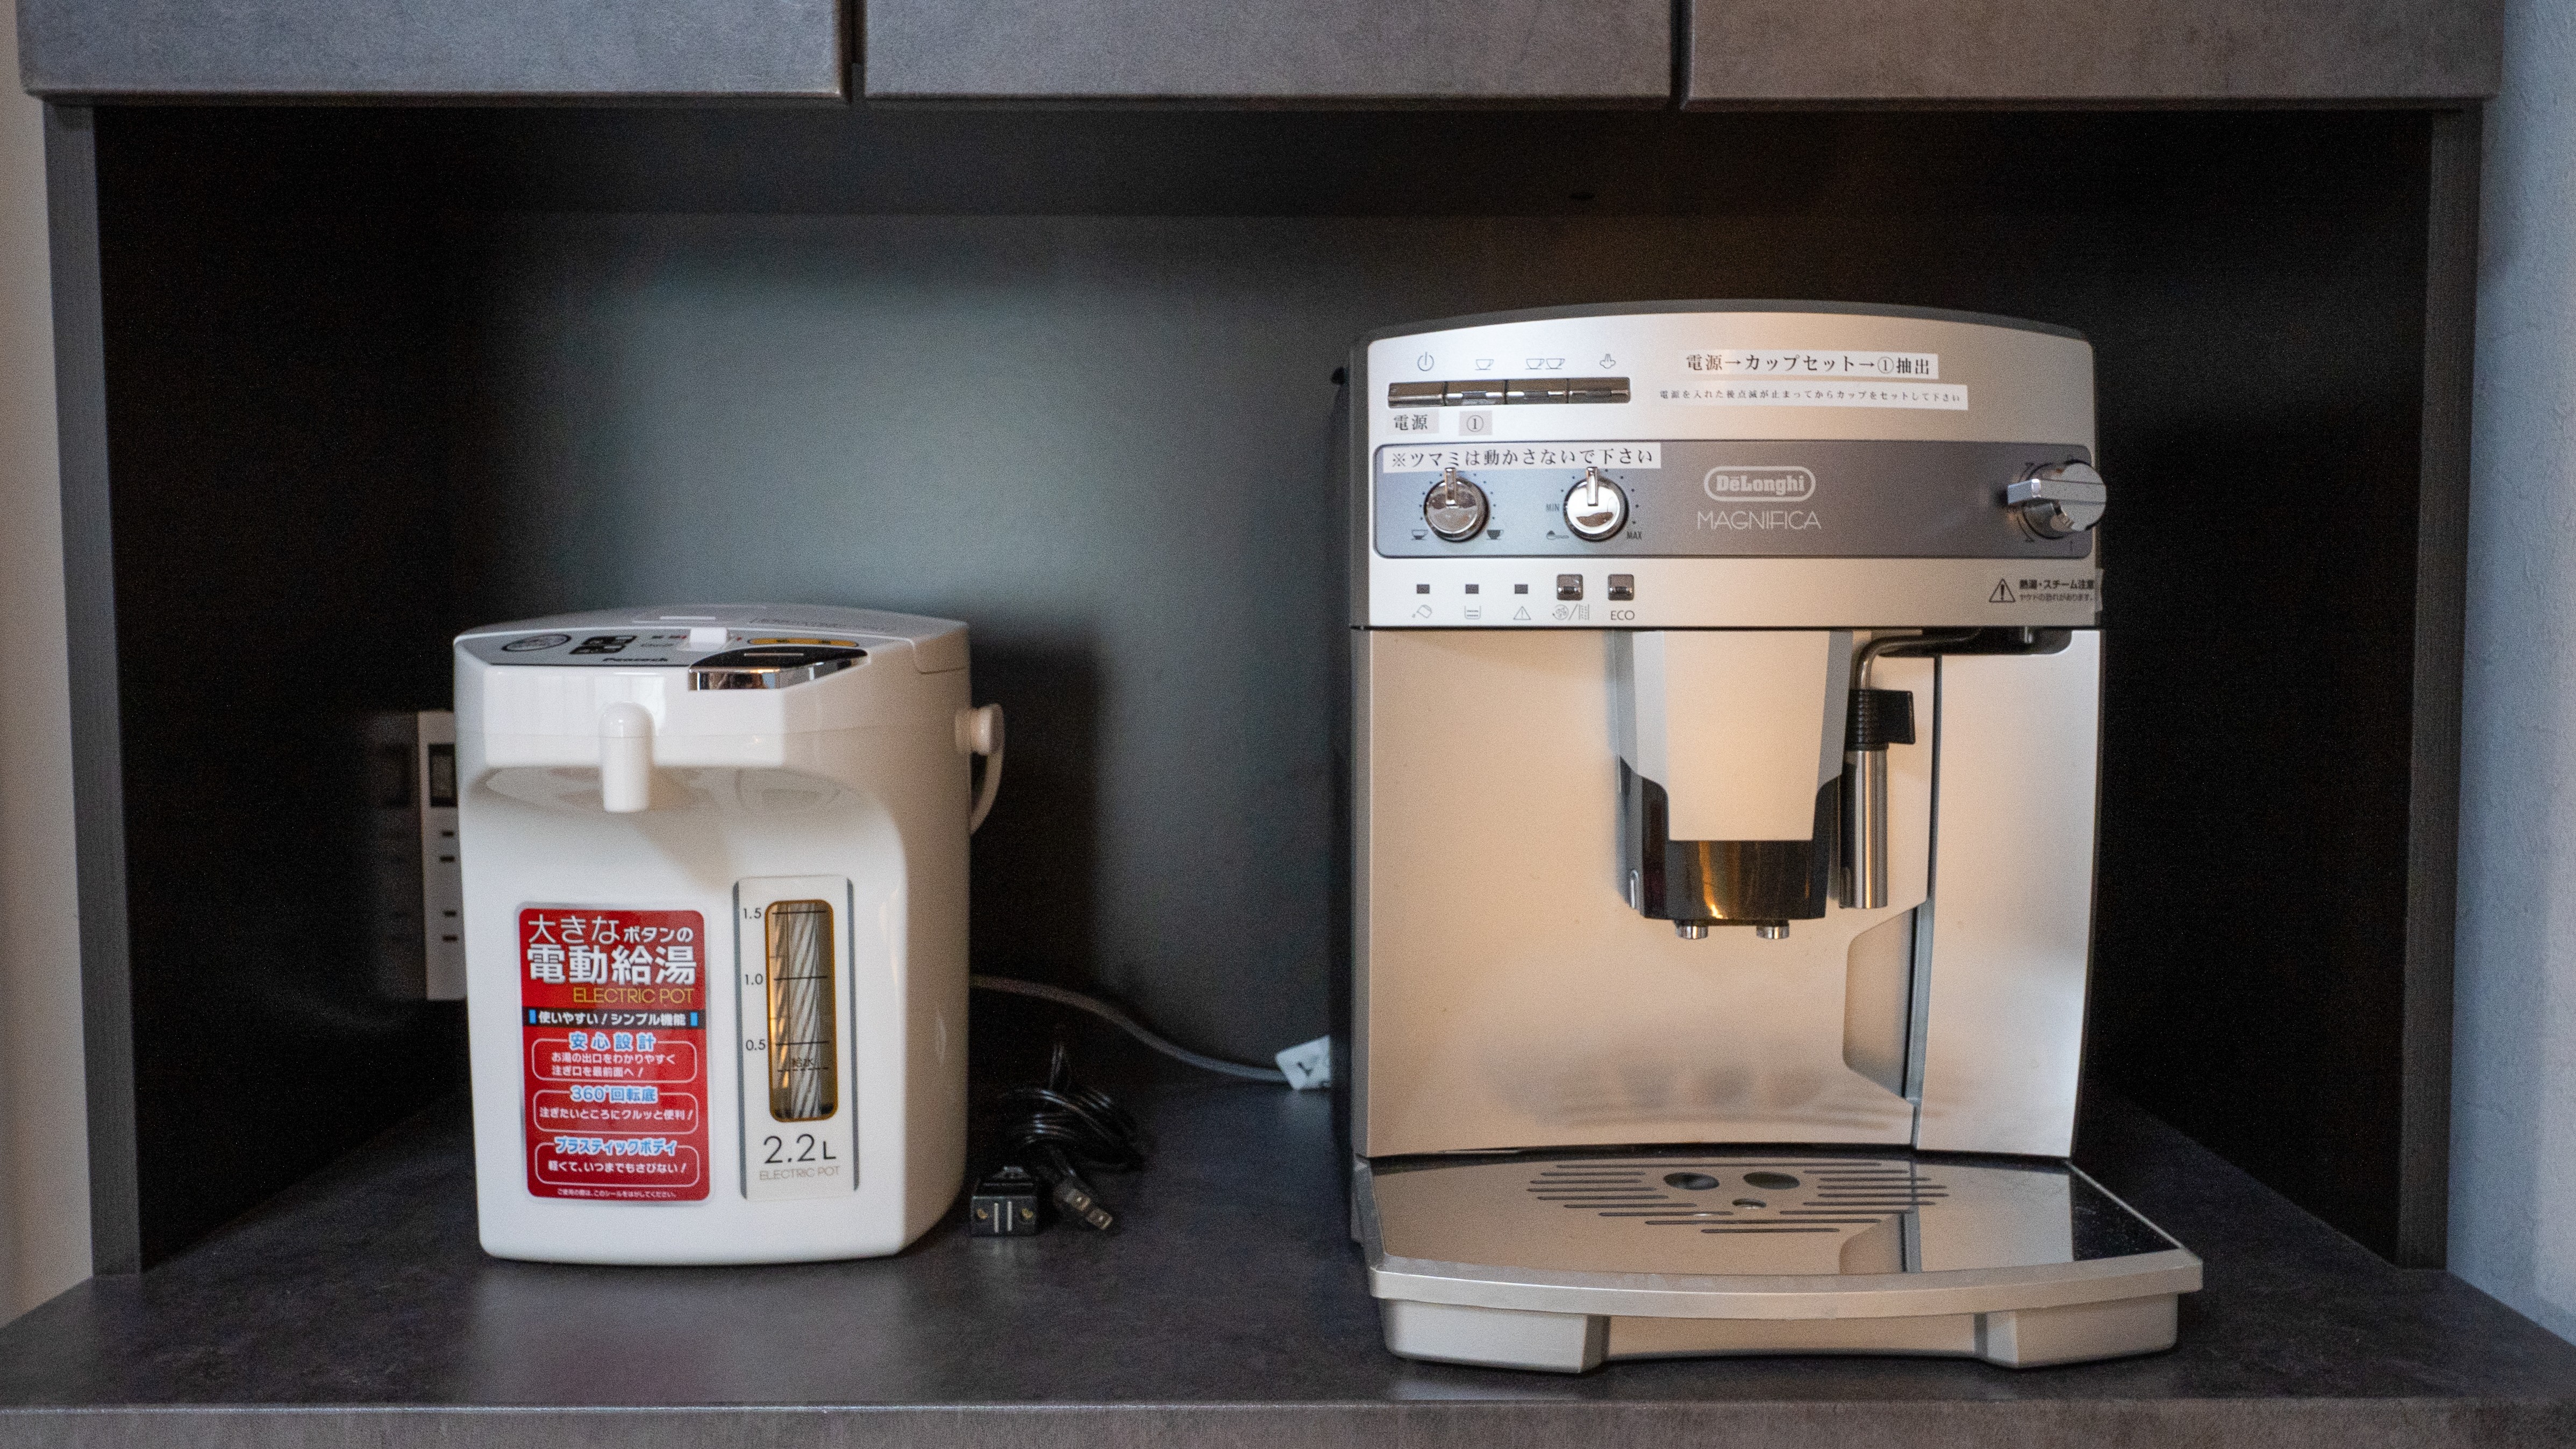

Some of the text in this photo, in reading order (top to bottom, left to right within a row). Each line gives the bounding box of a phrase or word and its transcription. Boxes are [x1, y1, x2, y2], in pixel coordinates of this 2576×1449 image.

[1394, 413, 1428, 431] 電源
[1392, 448, 1653, 468] ※ツマミは動かさないで下さい
[1546, 503, 1560, 511] MIN
[1697, 510, 1822, 530] MAGNIFICA
[1626, 531, 1643, 540] MAX
[1610, 610, 1635, 621] ECO
[743, 908, 762, 919] 1.5
[527, 944, 697, 985] 電動給湯
[745, 974, 763, 986] 1.0
[573, 987, 694, 1004] ELECTRIC POT
[569, 1031, 657, 1051] 安心設計
[746, 1039, 766, 1051] 0.5
[570, 1086, 658, 1103] 360°回転底
[554, 1136, 677, 1157] プラスティックボディ
[760, 1165, 841, 1182] ELECTRIC POT
